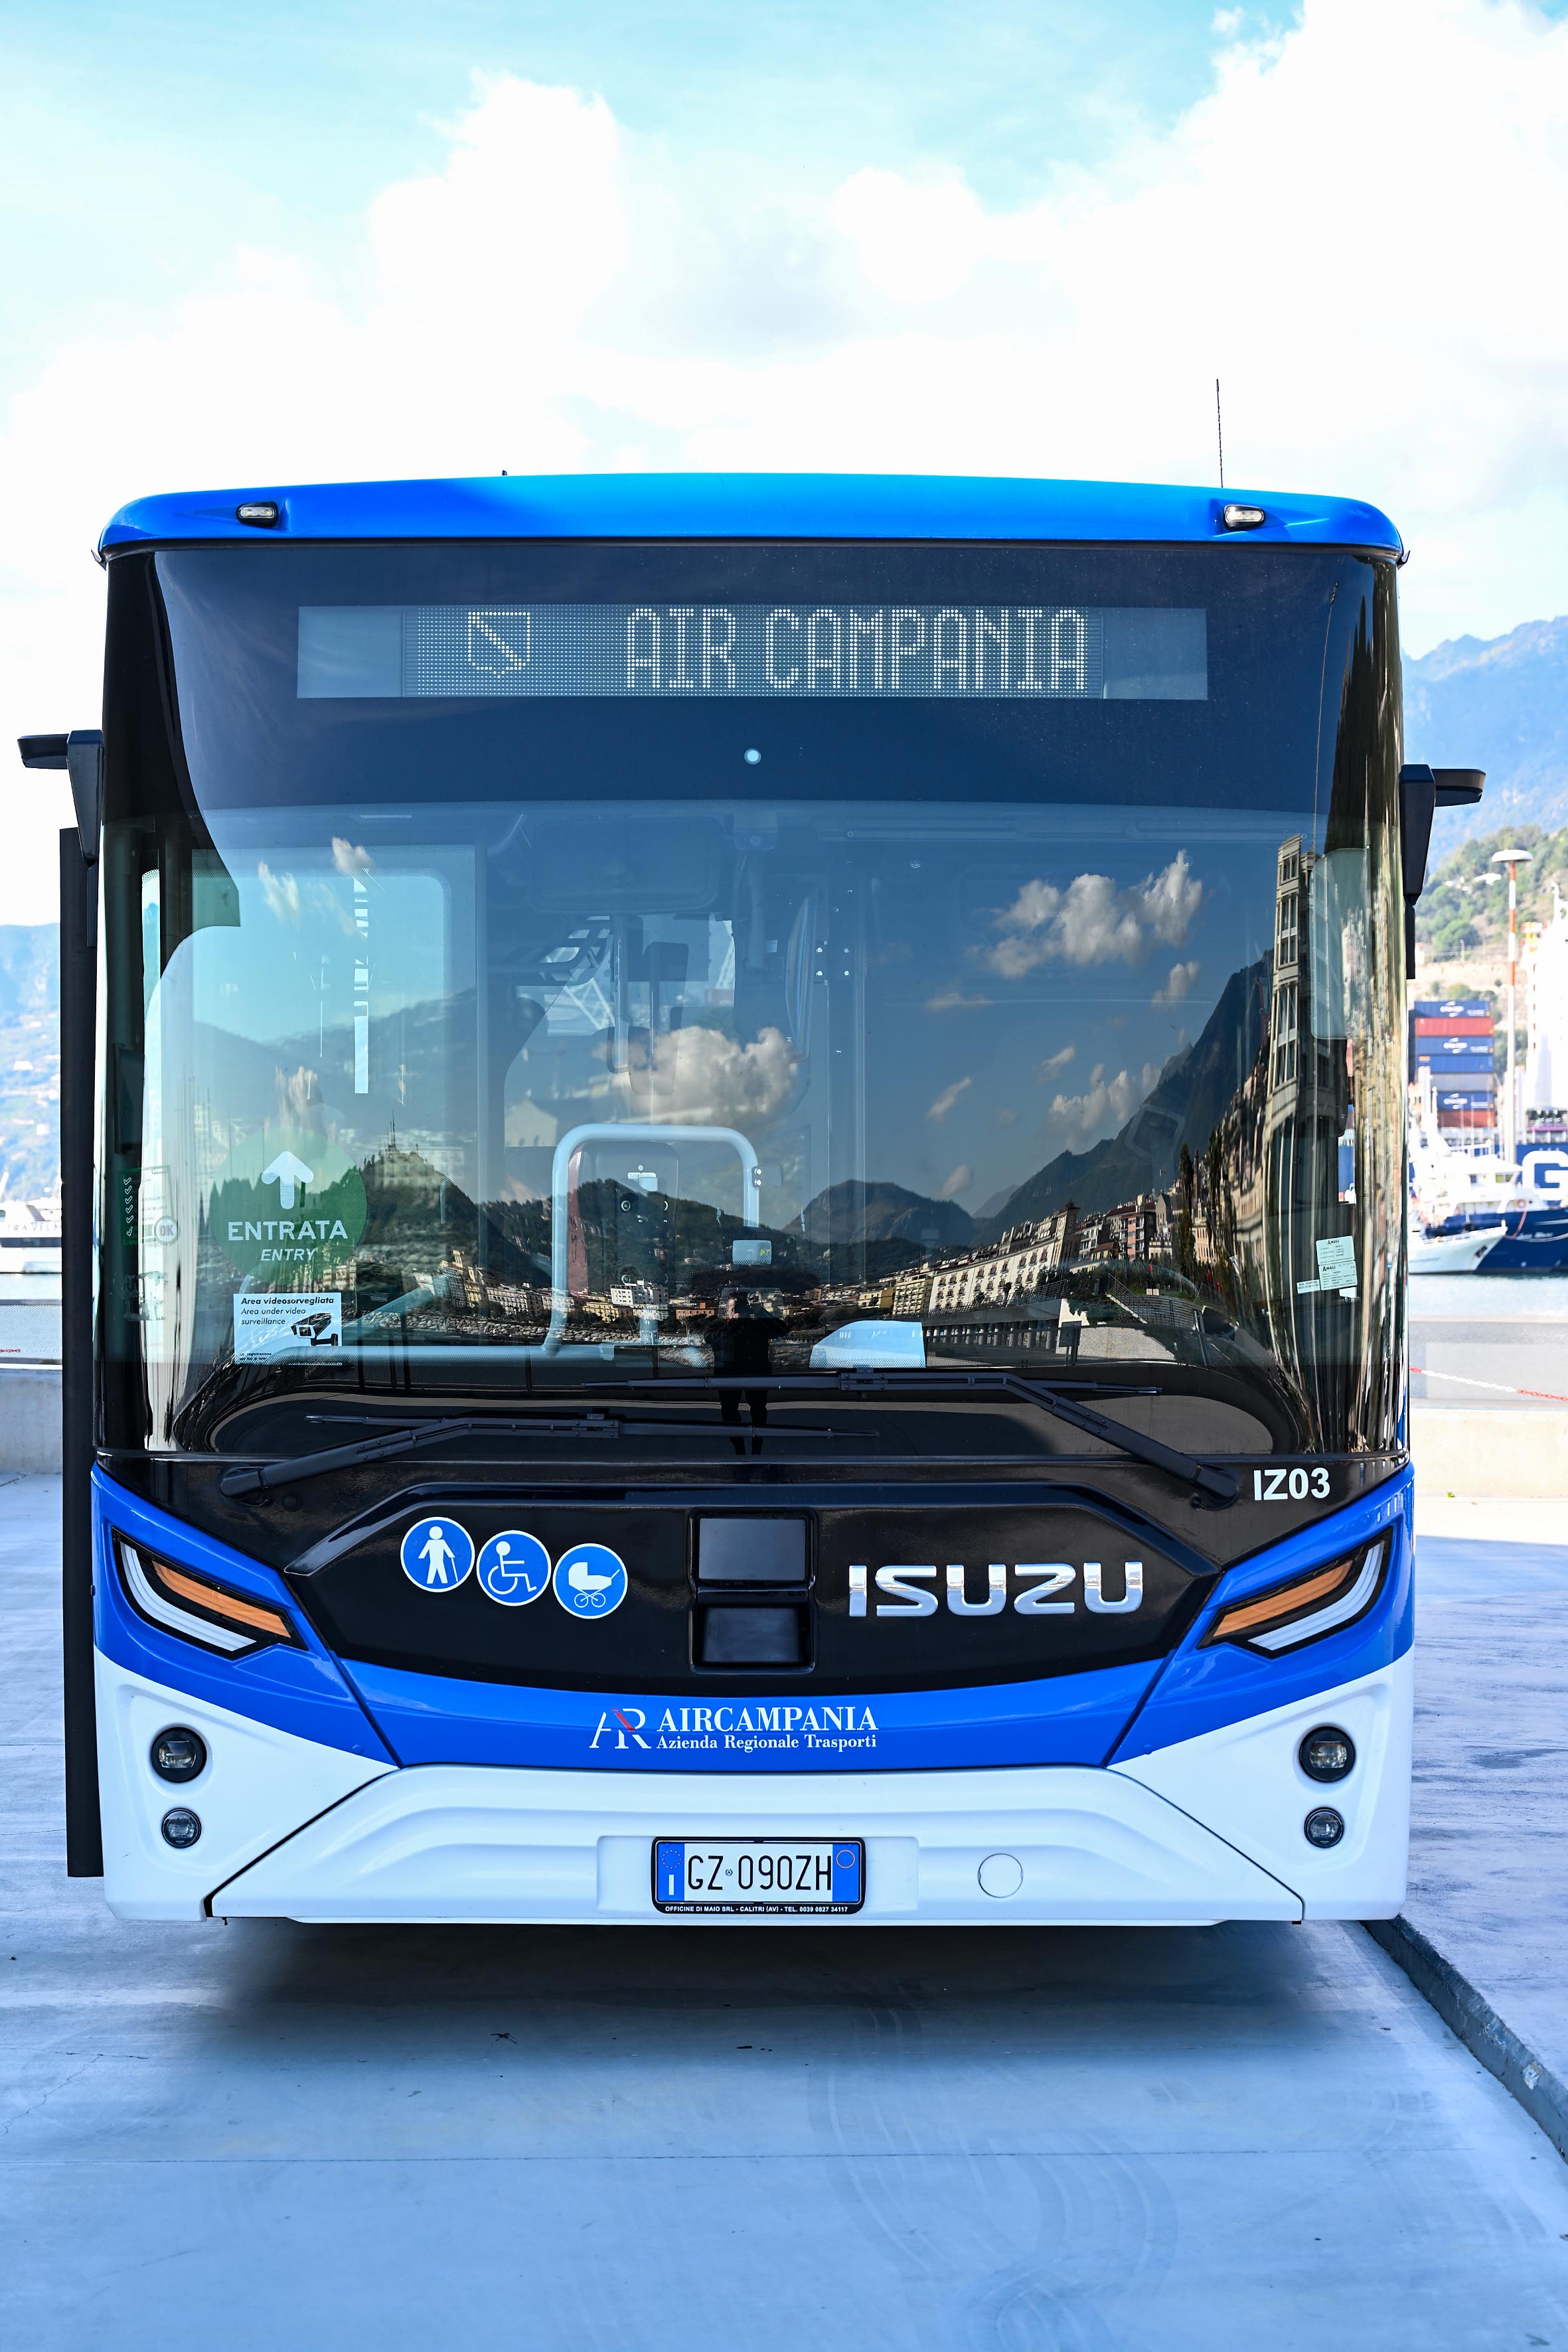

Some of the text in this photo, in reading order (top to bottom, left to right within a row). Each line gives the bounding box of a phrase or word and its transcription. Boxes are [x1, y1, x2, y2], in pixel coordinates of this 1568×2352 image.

[627, 608, 1085, 690] AIR CAMPANIA
[160, 1225, 174, 1236] OK
[228, 1219, 349, 1241] ENTRATA
[260, 1248, 317, 1261] ENTRY
[264, 1296, 334, 1306] videosorvegliata
[1253, 1467, 1330, 1501] IZ03
[848, 1561, 1143, 1617] ISUZU
[657, 1706, 879, 1732] AIRCAMPANIA
[657, 1734, 877, 1753] Azienda Regionale Trasporti
